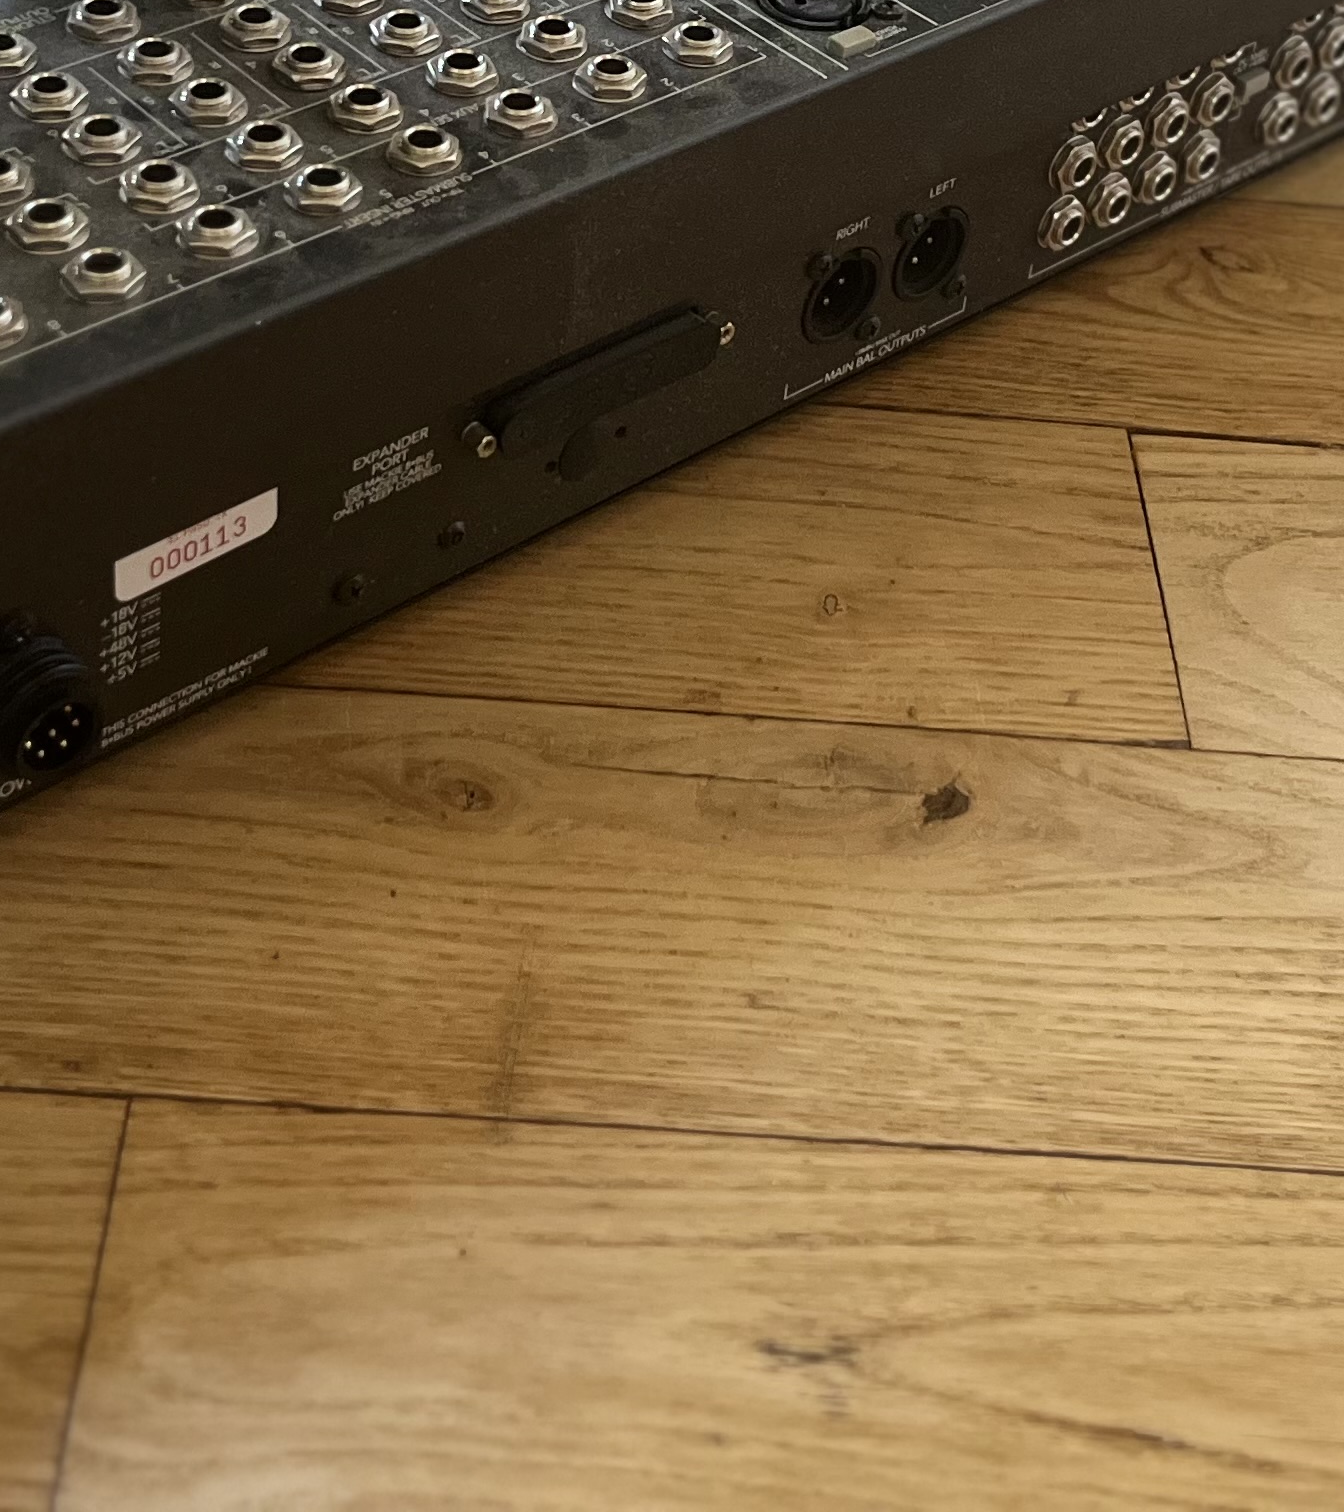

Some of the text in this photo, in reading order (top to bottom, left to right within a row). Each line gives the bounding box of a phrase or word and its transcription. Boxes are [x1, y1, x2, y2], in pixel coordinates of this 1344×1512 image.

[343, 172, 473, 229] SUBMASTER INSERT
[929, 177, 957, 199] LEFT
[835, 215, 872, 241] RIGHT
[824, 360, 855, 384] MAIN
[856, 350, 876, 368] BAL
[878, 324, 927, 357] OUTPUTS
[352, 426, 429, 472] EXPANDER
[371, 448, 410, 476] PORT
[149, 515, 248, 580] 000113
[100, 601, 138, 627] +18V
[99, 631, 138, 658] +48V
[99, 647, 138, 672] +12V
[107, 660, 137, 684] +5V
[102, 646, 269, 737] THIS CONNECTION FOR MACKIE
[136, 703, 177, 730] POWER
[178, 683, 216, 710] SUPPLY
[217, 666, 252, 689] ONLY!
